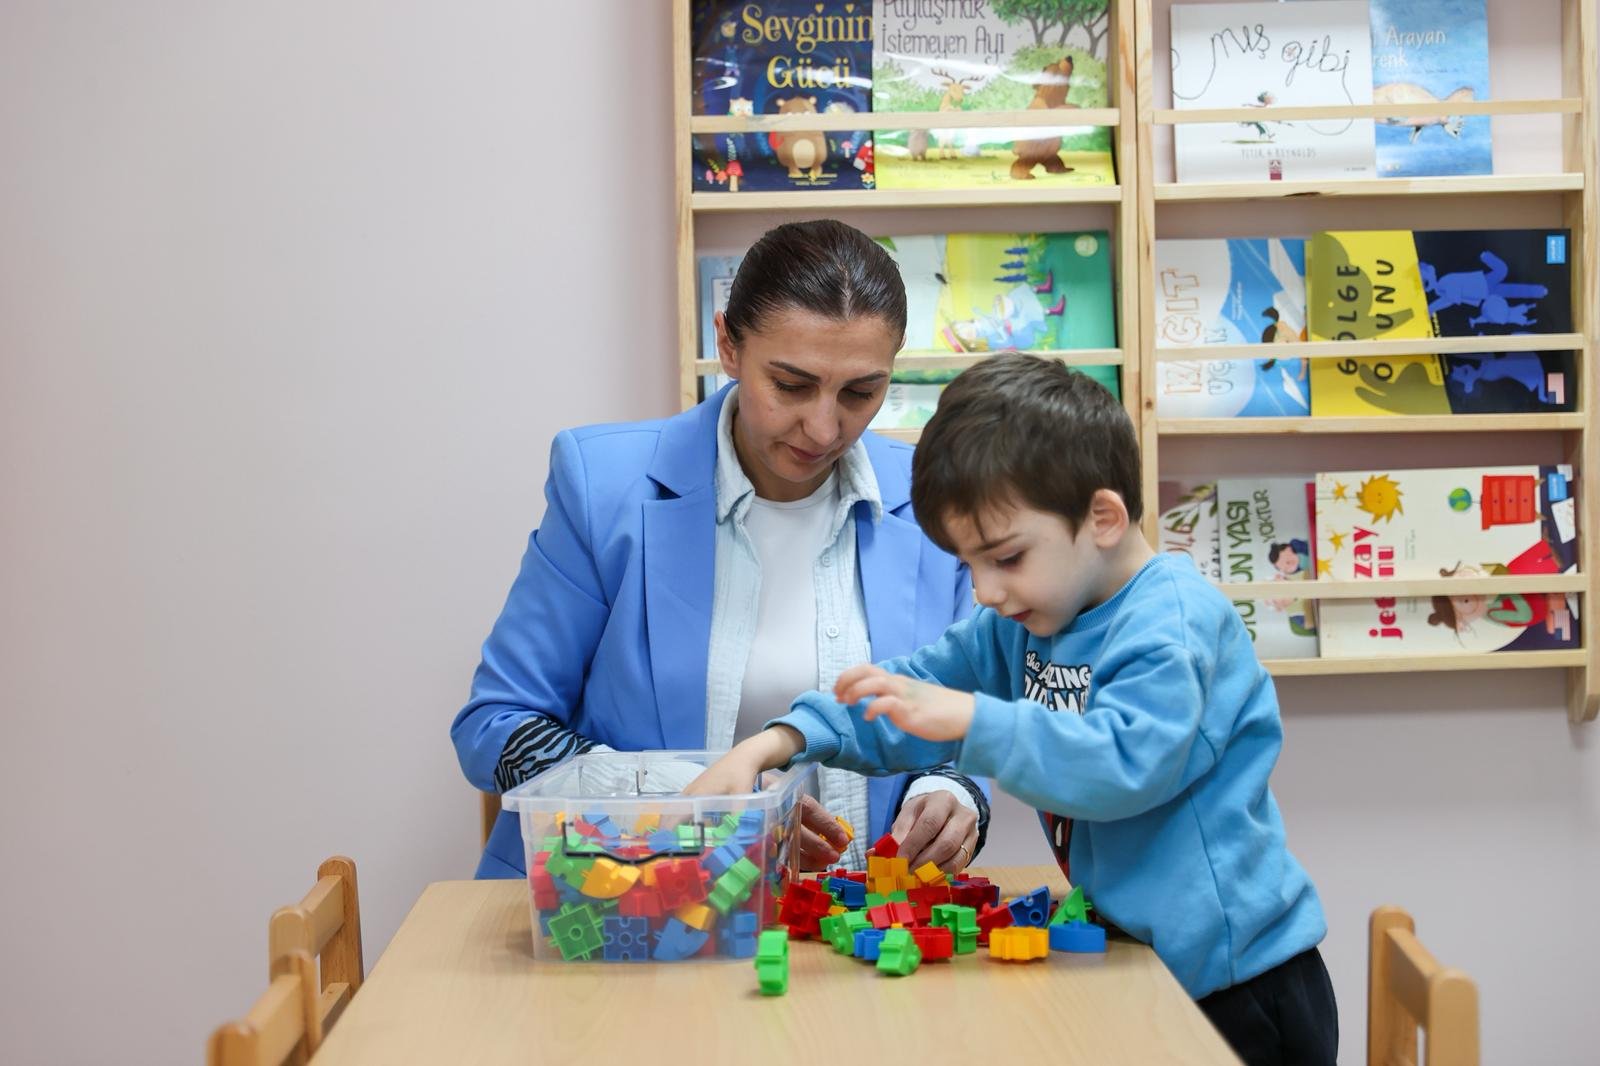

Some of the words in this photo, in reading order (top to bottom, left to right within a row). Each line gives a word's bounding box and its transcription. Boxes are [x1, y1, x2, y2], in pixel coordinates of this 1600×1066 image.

[741, 3, 873, 54] Sevginin
[881, 23, 968, 60] İstemeyen
[1386, 23, 1446, 52] Arayan
[766, 54, 852, 89] Gücü
[1280, 34, 1352, 88] gibi
[1373, 258, 1396, 382] OUNU
[1252, 488, 1277, 543] YOKTUR
[1352, 525, 1380, 579] zay
[1026, 652, 1041, 672] the
